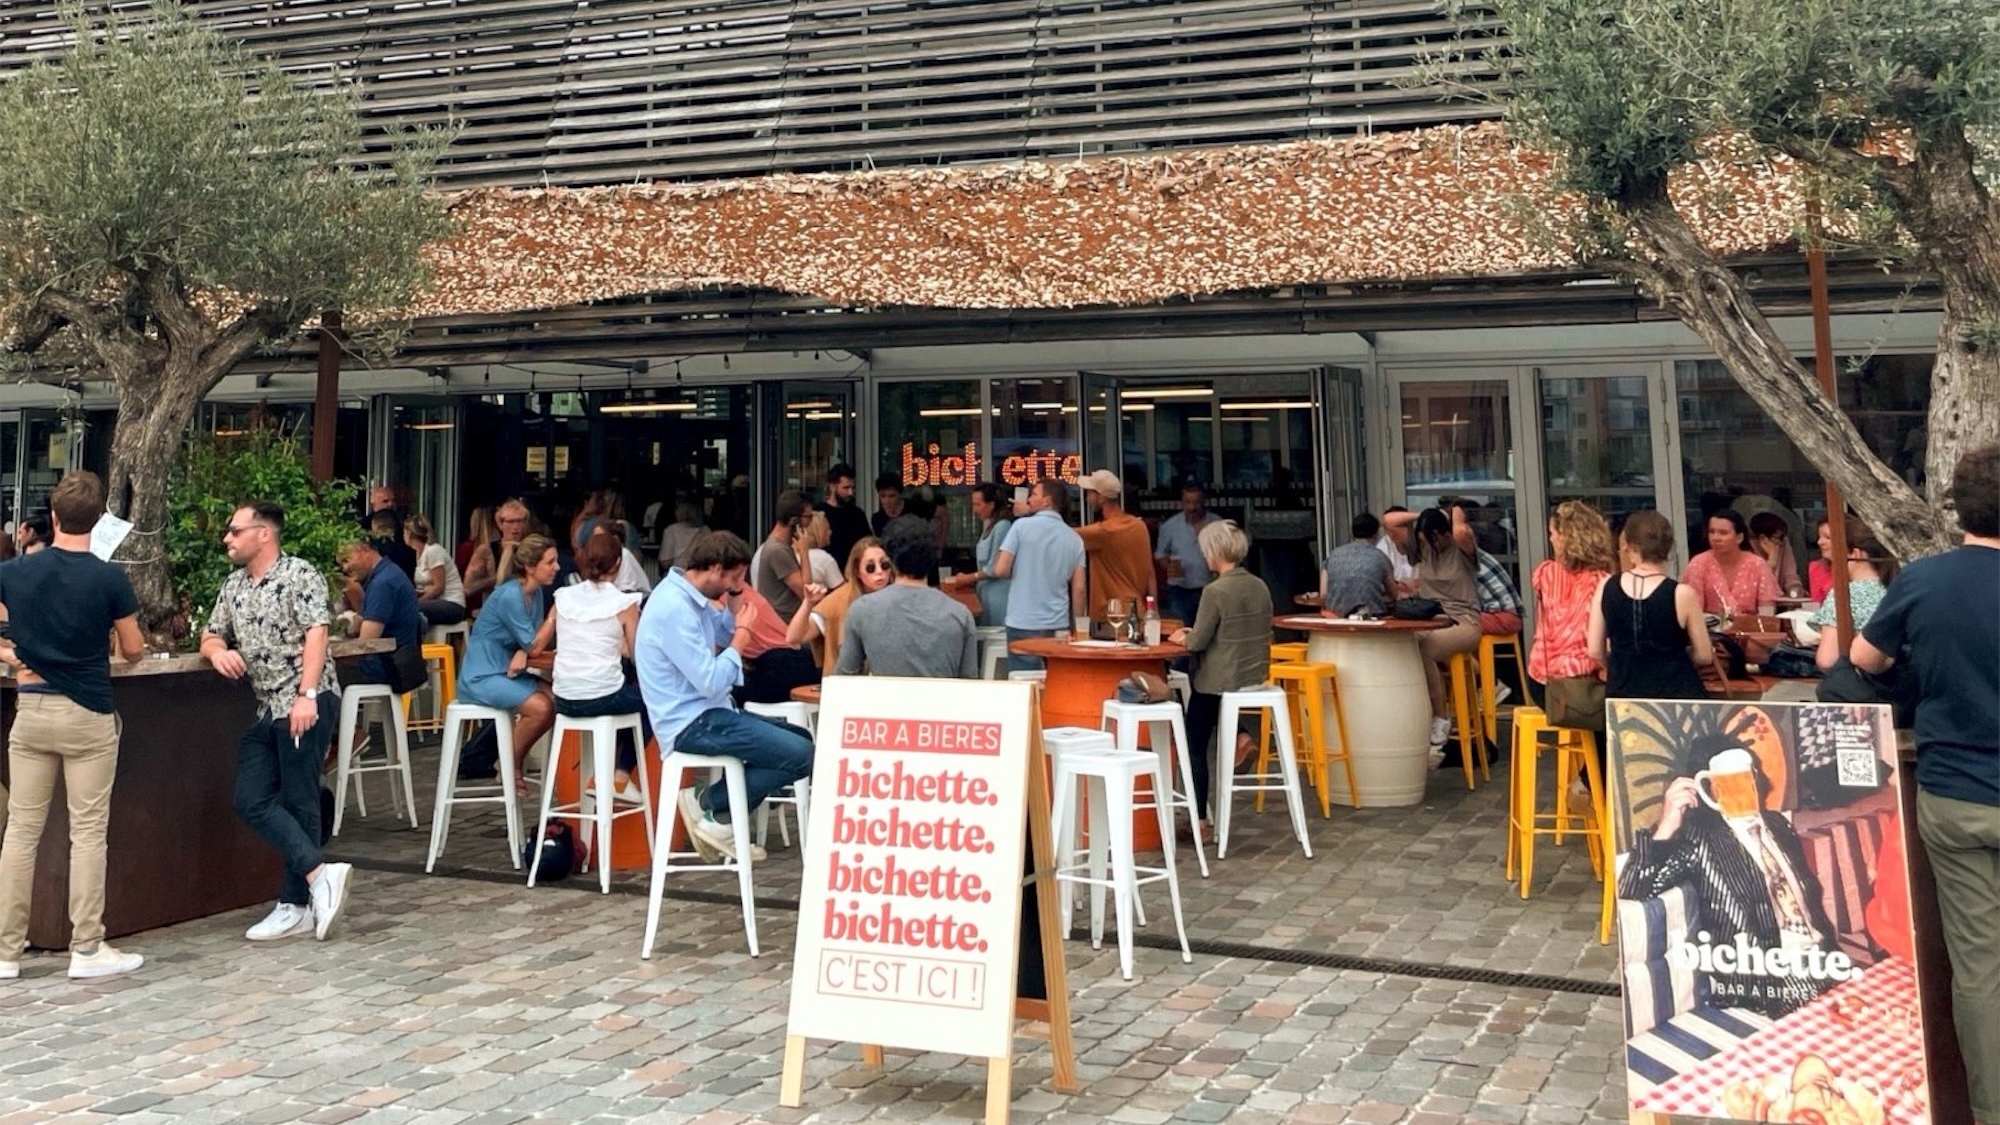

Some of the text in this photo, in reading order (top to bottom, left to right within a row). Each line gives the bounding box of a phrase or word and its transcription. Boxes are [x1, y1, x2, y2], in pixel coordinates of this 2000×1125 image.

[843, 720, 999, 750] BAR A BIERES
[837, 757, 998, 806] bichette.
[832, 804, 995, 854] bichette.
[827, 851, 992, 903] bichette.
[823, 898, 989, 953] bichette.
[826, 955, 907, 994] C'EST
[918, 965, 958, 1000] ICI
[1670, 929, 1864, 981] bichette.
[1717, 982, 1745, 996] BAR
[1751, 985, 1761, 998] A
